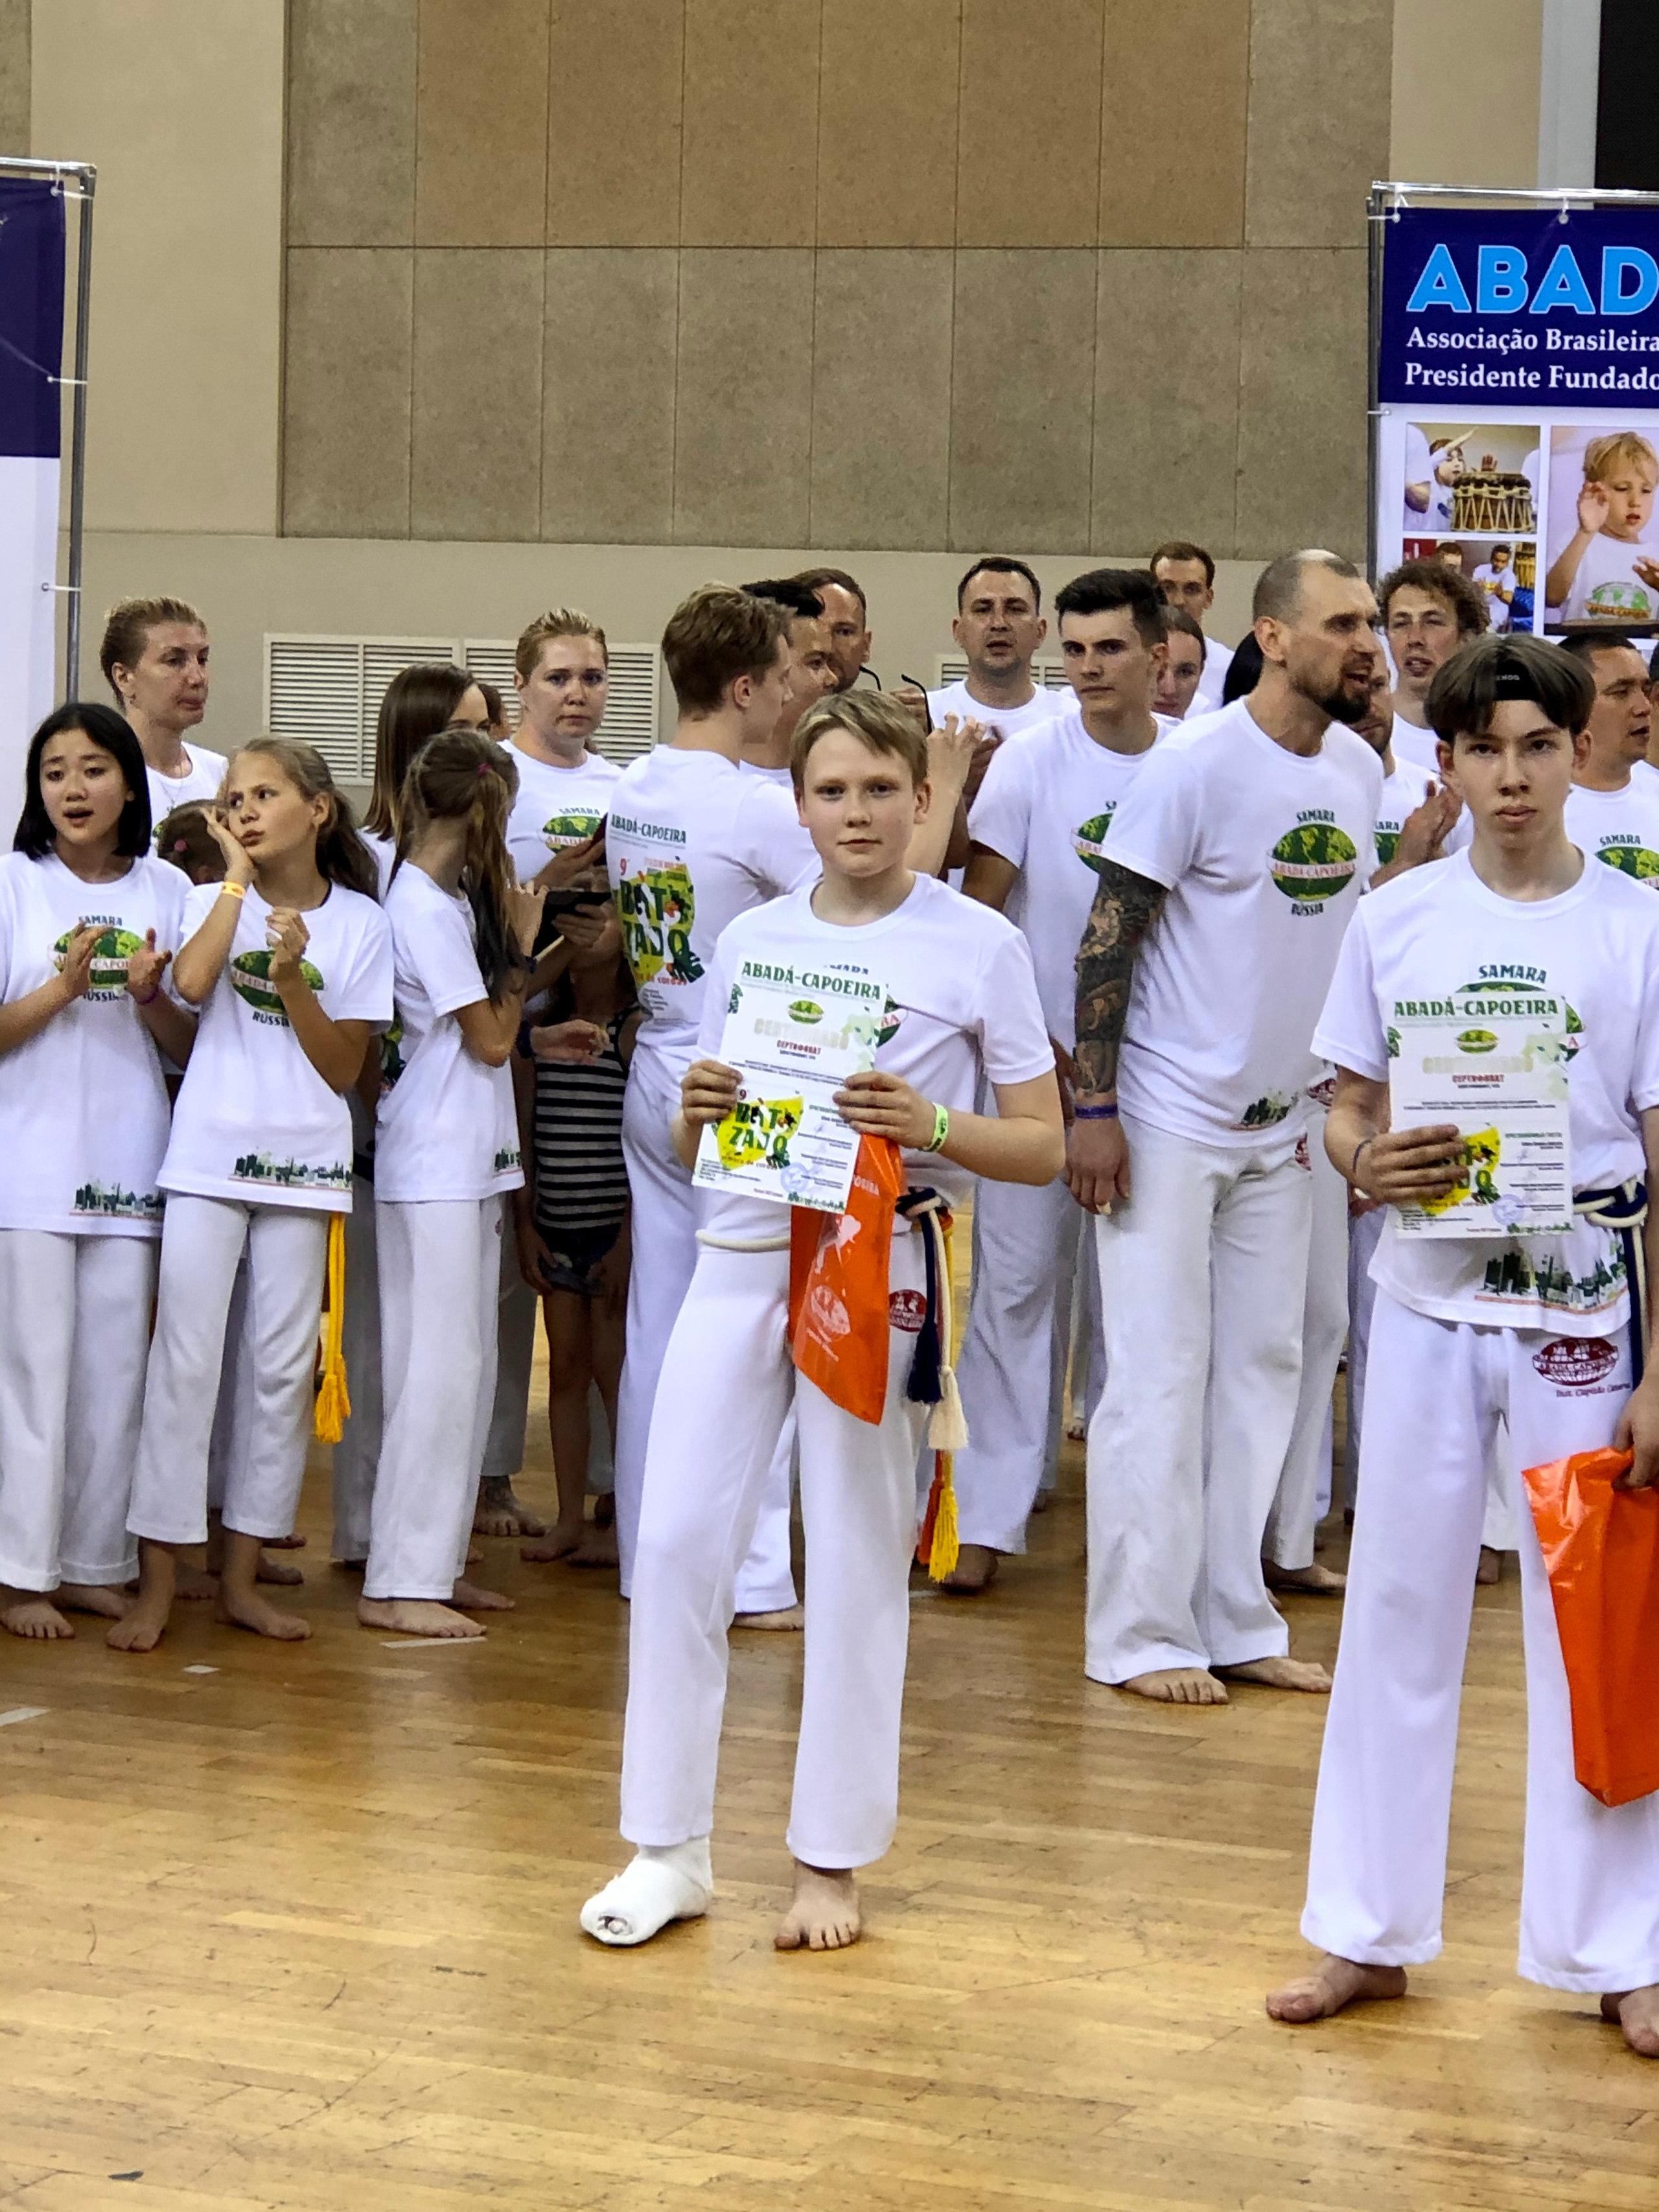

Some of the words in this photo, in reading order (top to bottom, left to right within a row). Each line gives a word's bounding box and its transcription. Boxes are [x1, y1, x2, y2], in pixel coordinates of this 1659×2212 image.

[1406, 243, 1659, 315] ABAD
[1406, 325, 1538, 355] Associação
[1404, 362, 1541, 388] Presidente
[1599, 834, 1641, 846] SAMARA
[741, 961, 881, 1000] ABADÁ-CAPOEIRA
[1478, 964, 1547, 984] SAMARA
[1394, 996, 1558, 1017] ABADÁ-CAPOEIRA
